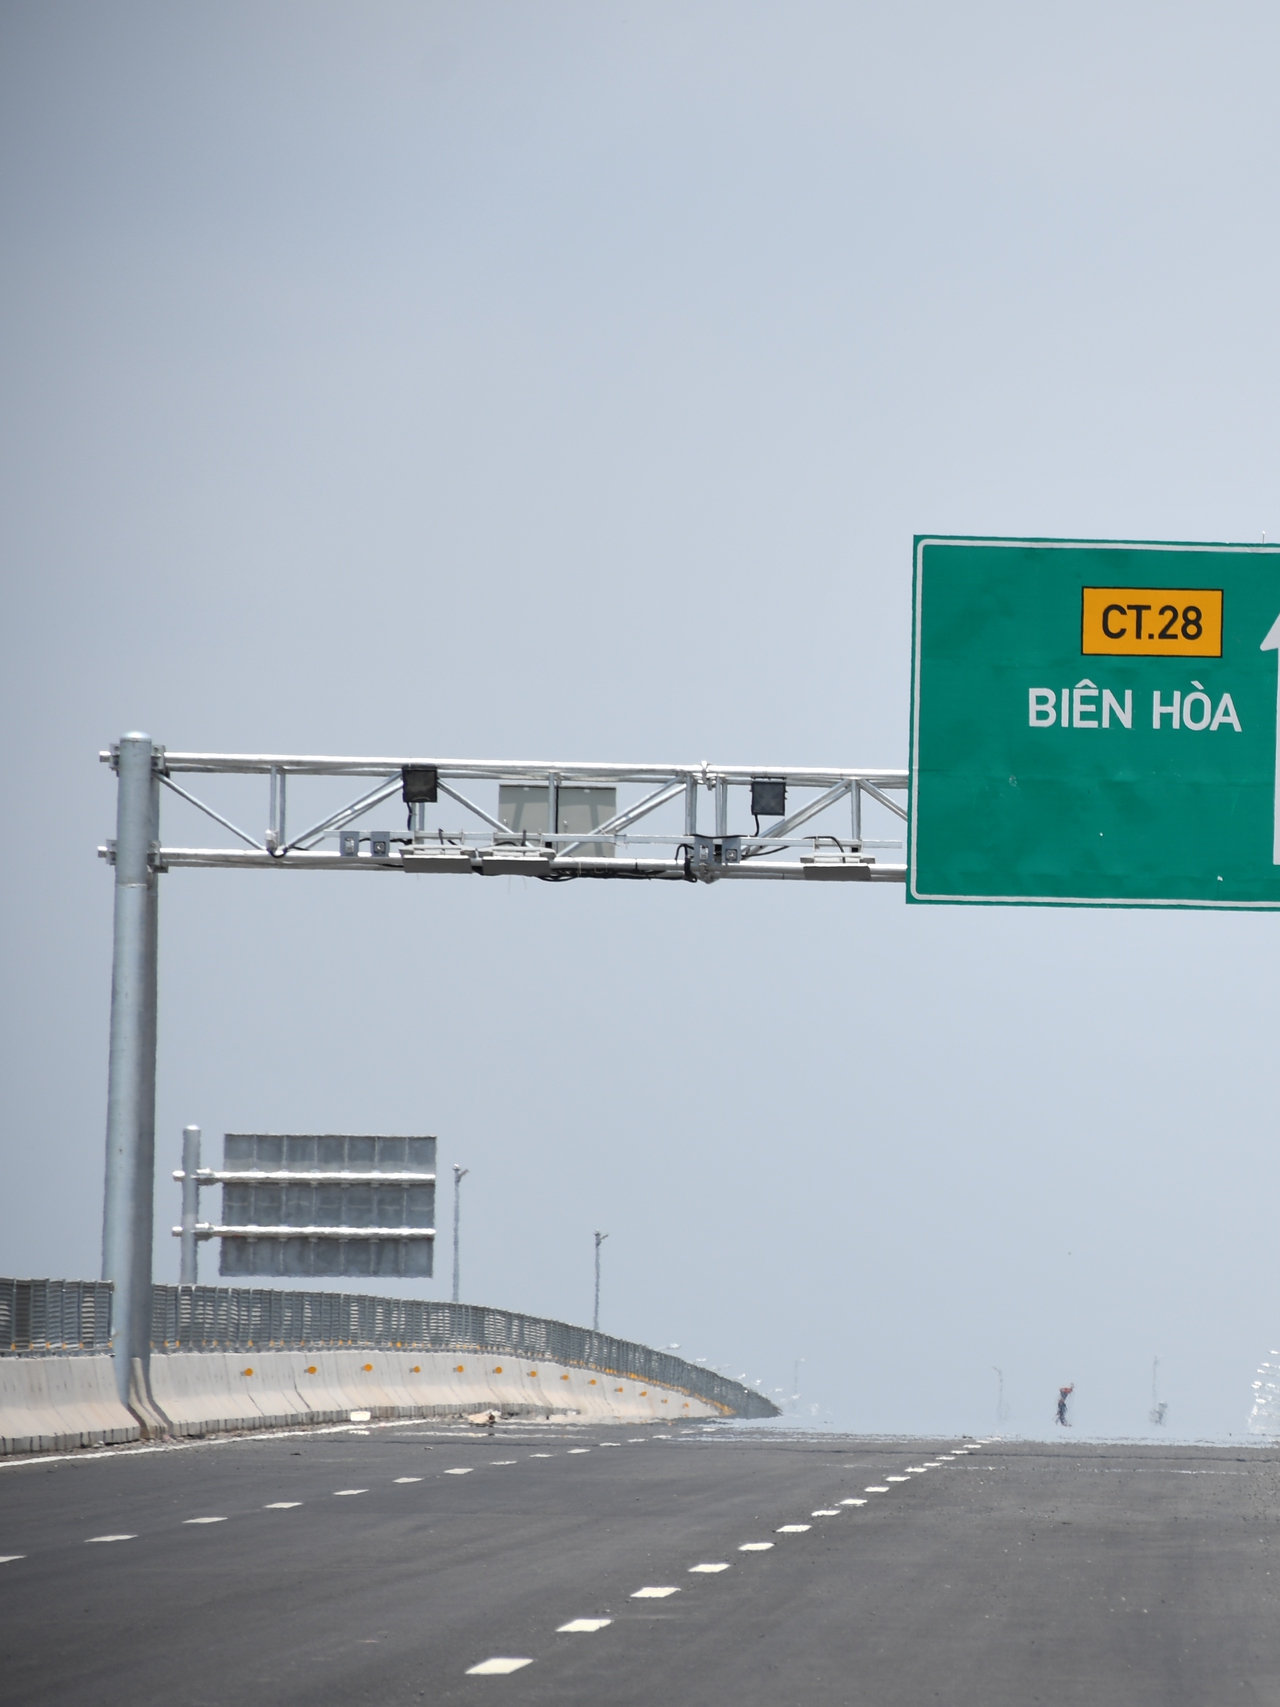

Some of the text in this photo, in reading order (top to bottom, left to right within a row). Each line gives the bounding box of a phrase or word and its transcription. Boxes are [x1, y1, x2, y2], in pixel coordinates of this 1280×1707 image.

[1102, 603, 1203, 640] CT.28
[1029, 678, 1242, 732] BIÊN HÒA
